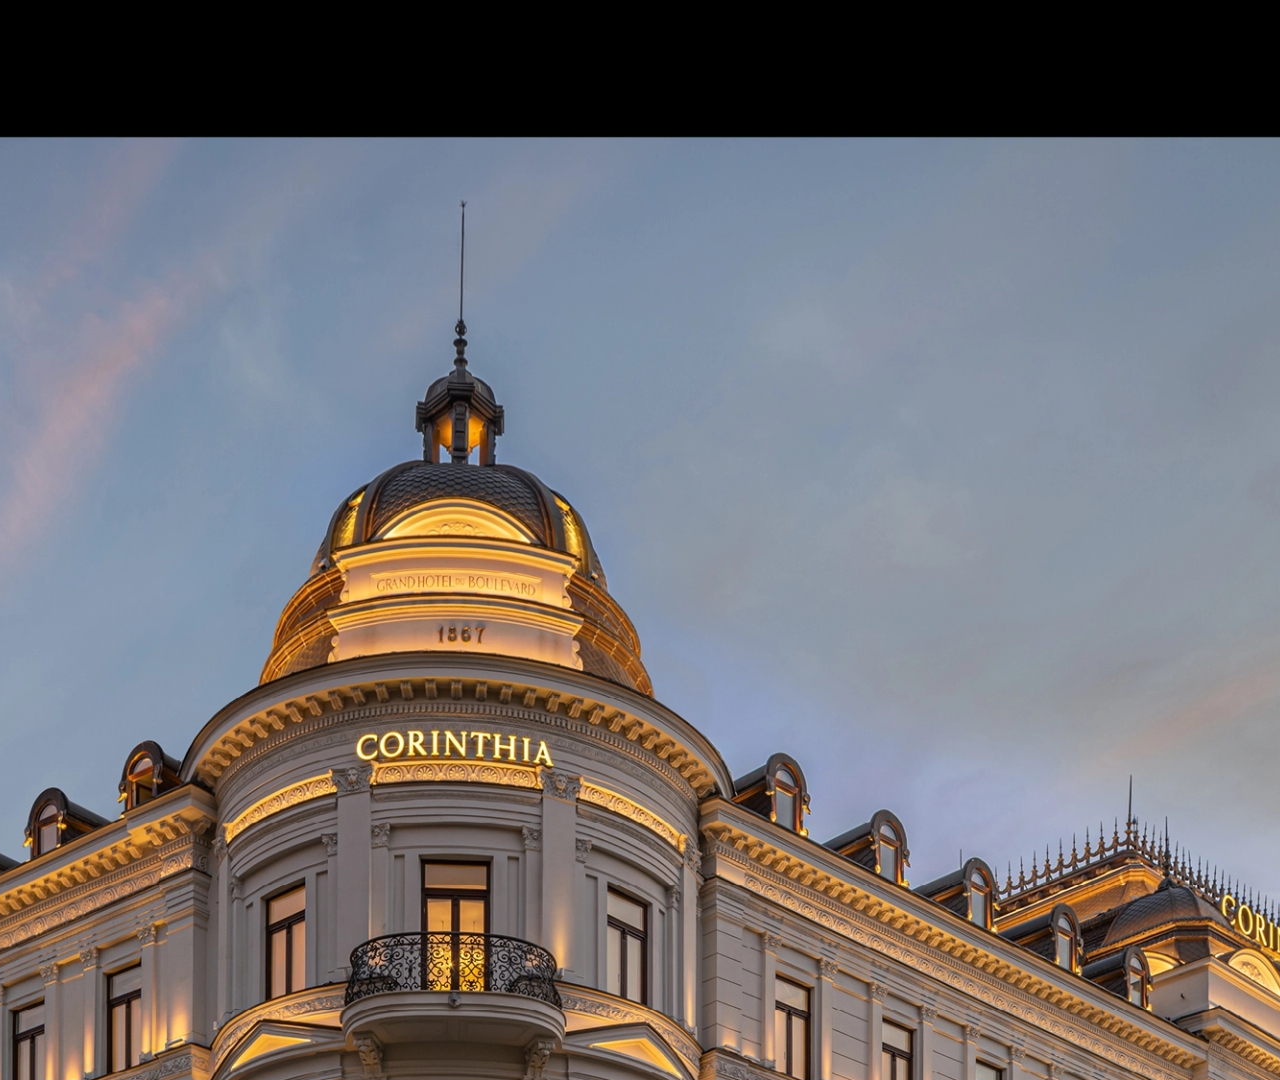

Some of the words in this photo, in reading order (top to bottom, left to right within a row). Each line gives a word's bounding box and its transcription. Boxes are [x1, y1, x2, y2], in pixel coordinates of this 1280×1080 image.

[376, 575, 416, 592] GRAND
[417, 575, 454, 589] HOTEL
[455, 577, 465, 586] DU
[468, 575, 536, 596] BOULEVARD
[437, 626, 486, 645] 1867
[356, 730, 554, 767] CORINTHIA
